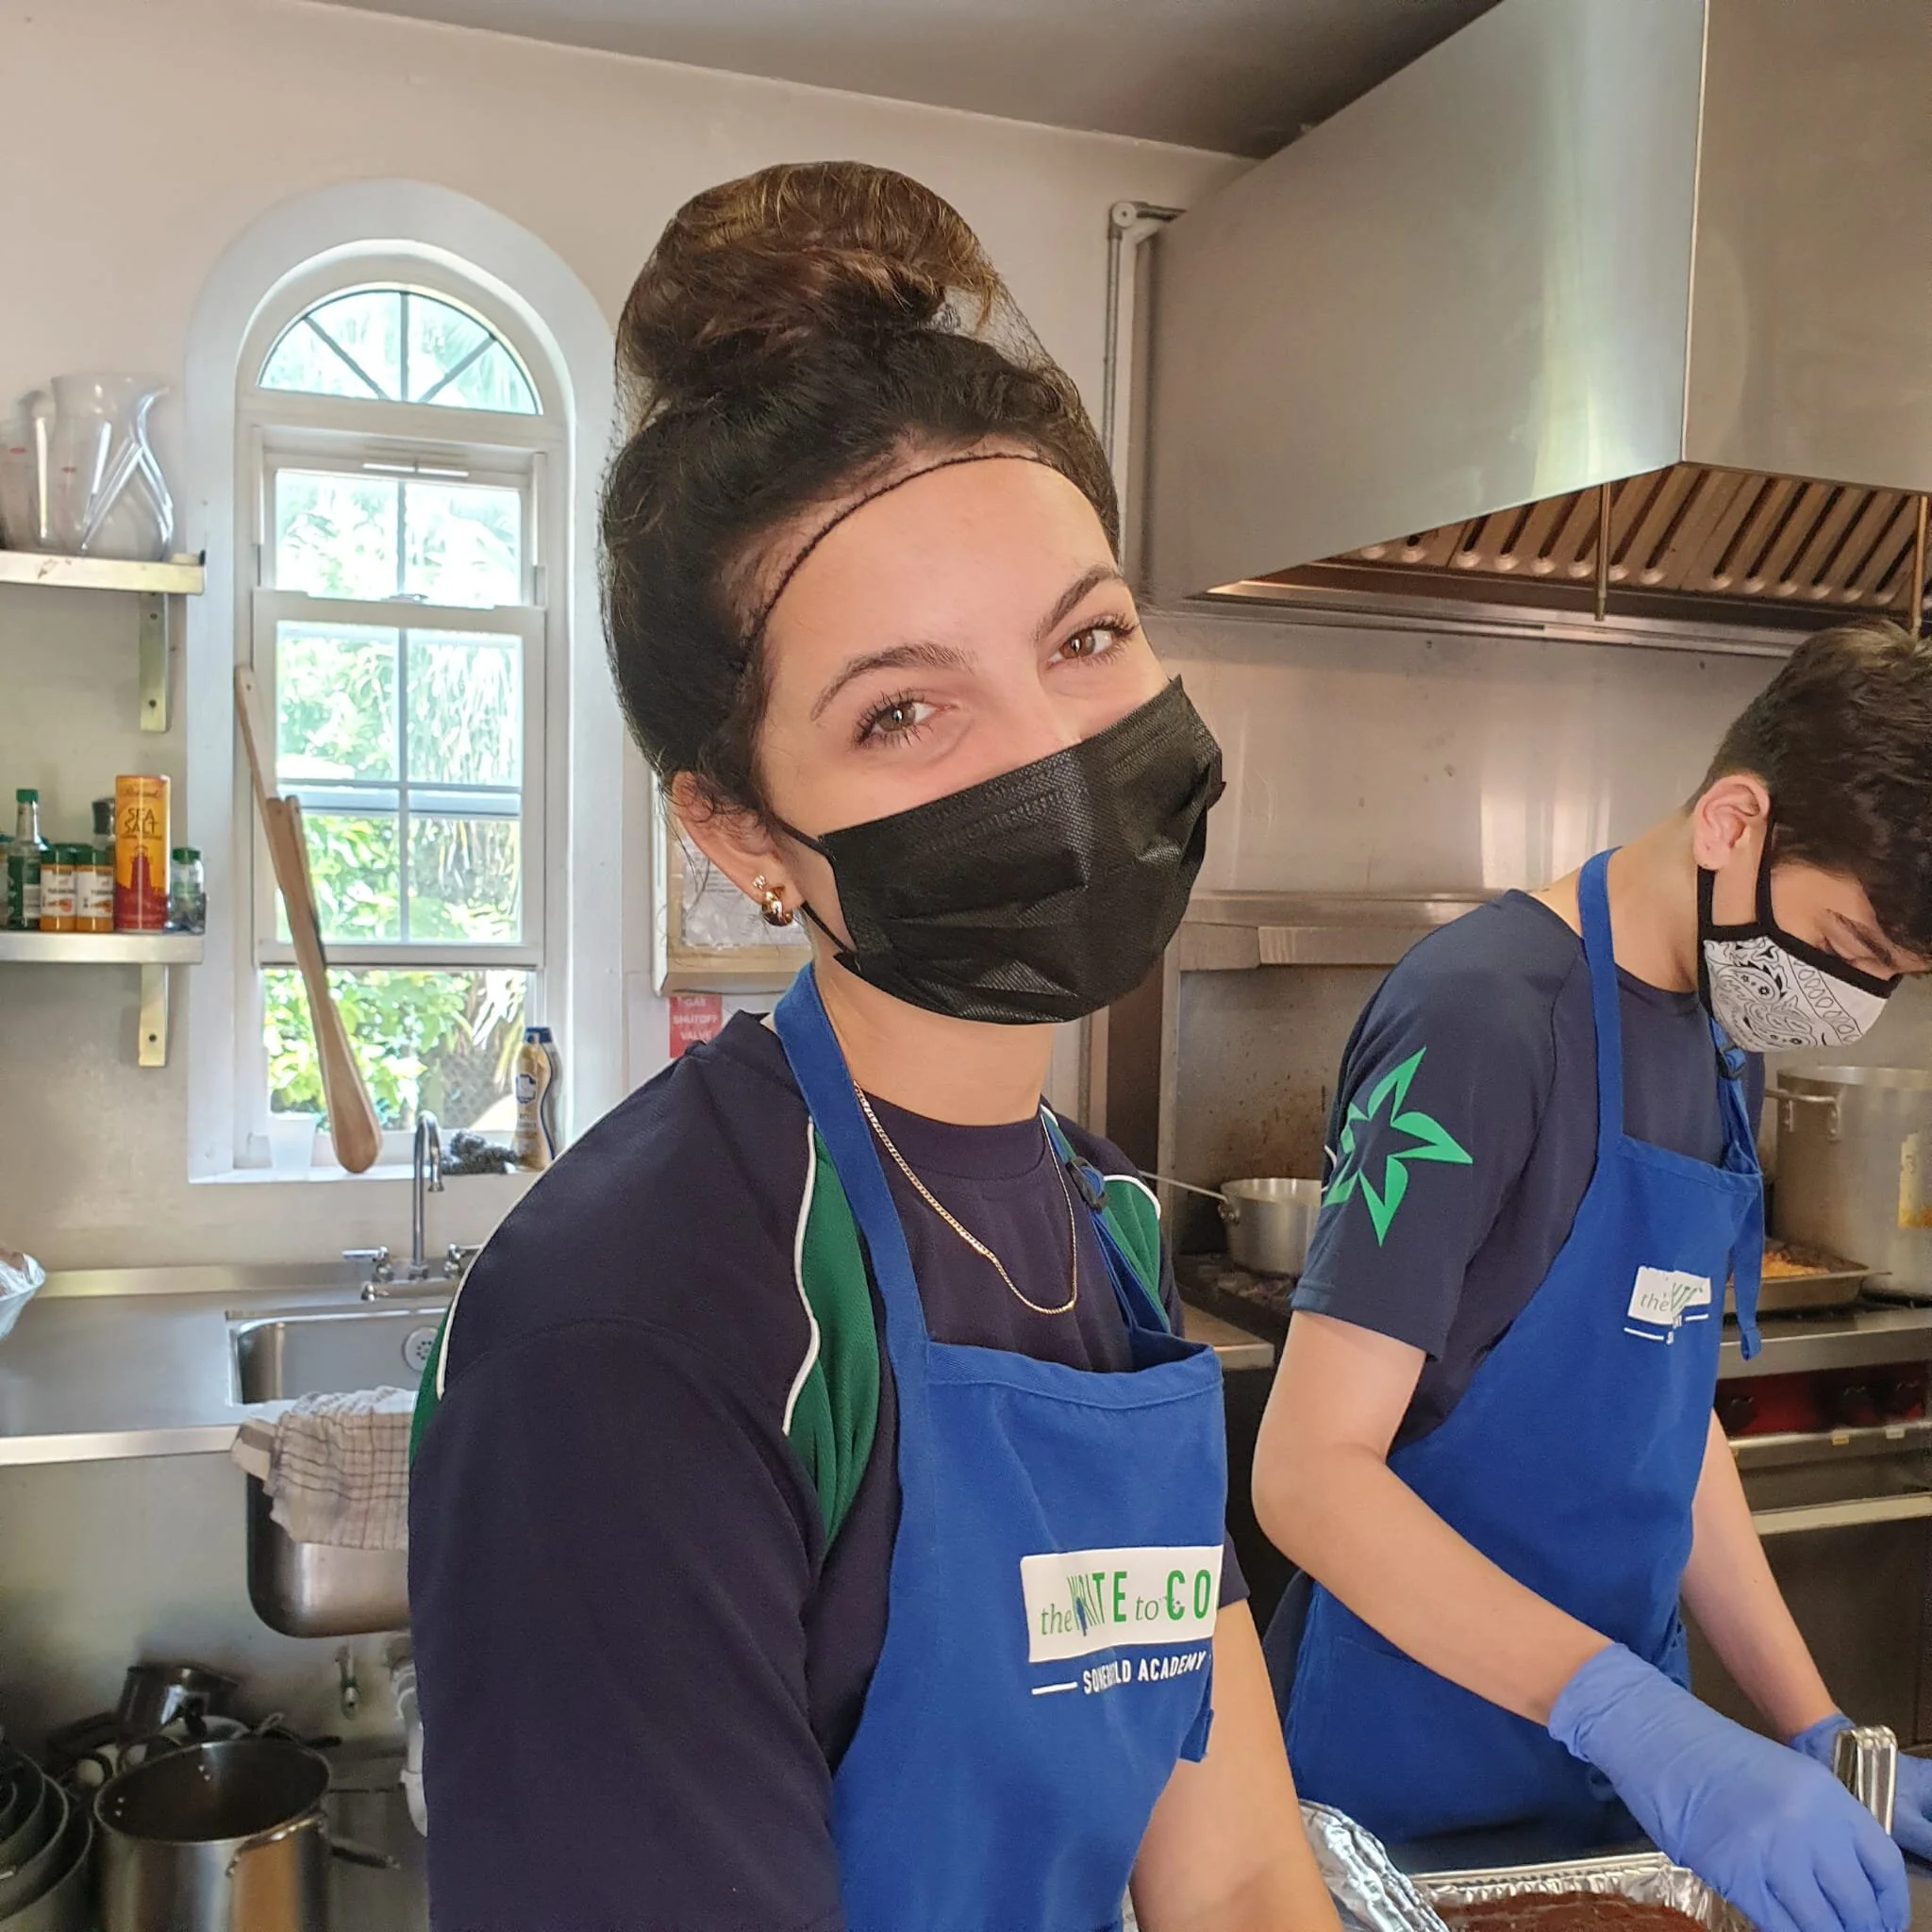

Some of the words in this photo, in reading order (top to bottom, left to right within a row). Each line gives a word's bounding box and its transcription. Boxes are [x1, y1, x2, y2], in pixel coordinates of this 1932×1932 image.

[127, 808, 156, 822] SEA
[124, 821, 159, 835] SALT
[1640, 1291, 1670, 1312] the
[1041, 1602, 1073, 1636] the
[1135, 1595, 1160, 1622] to
[1137, 1650, 1207, 1682] ACADEMY
